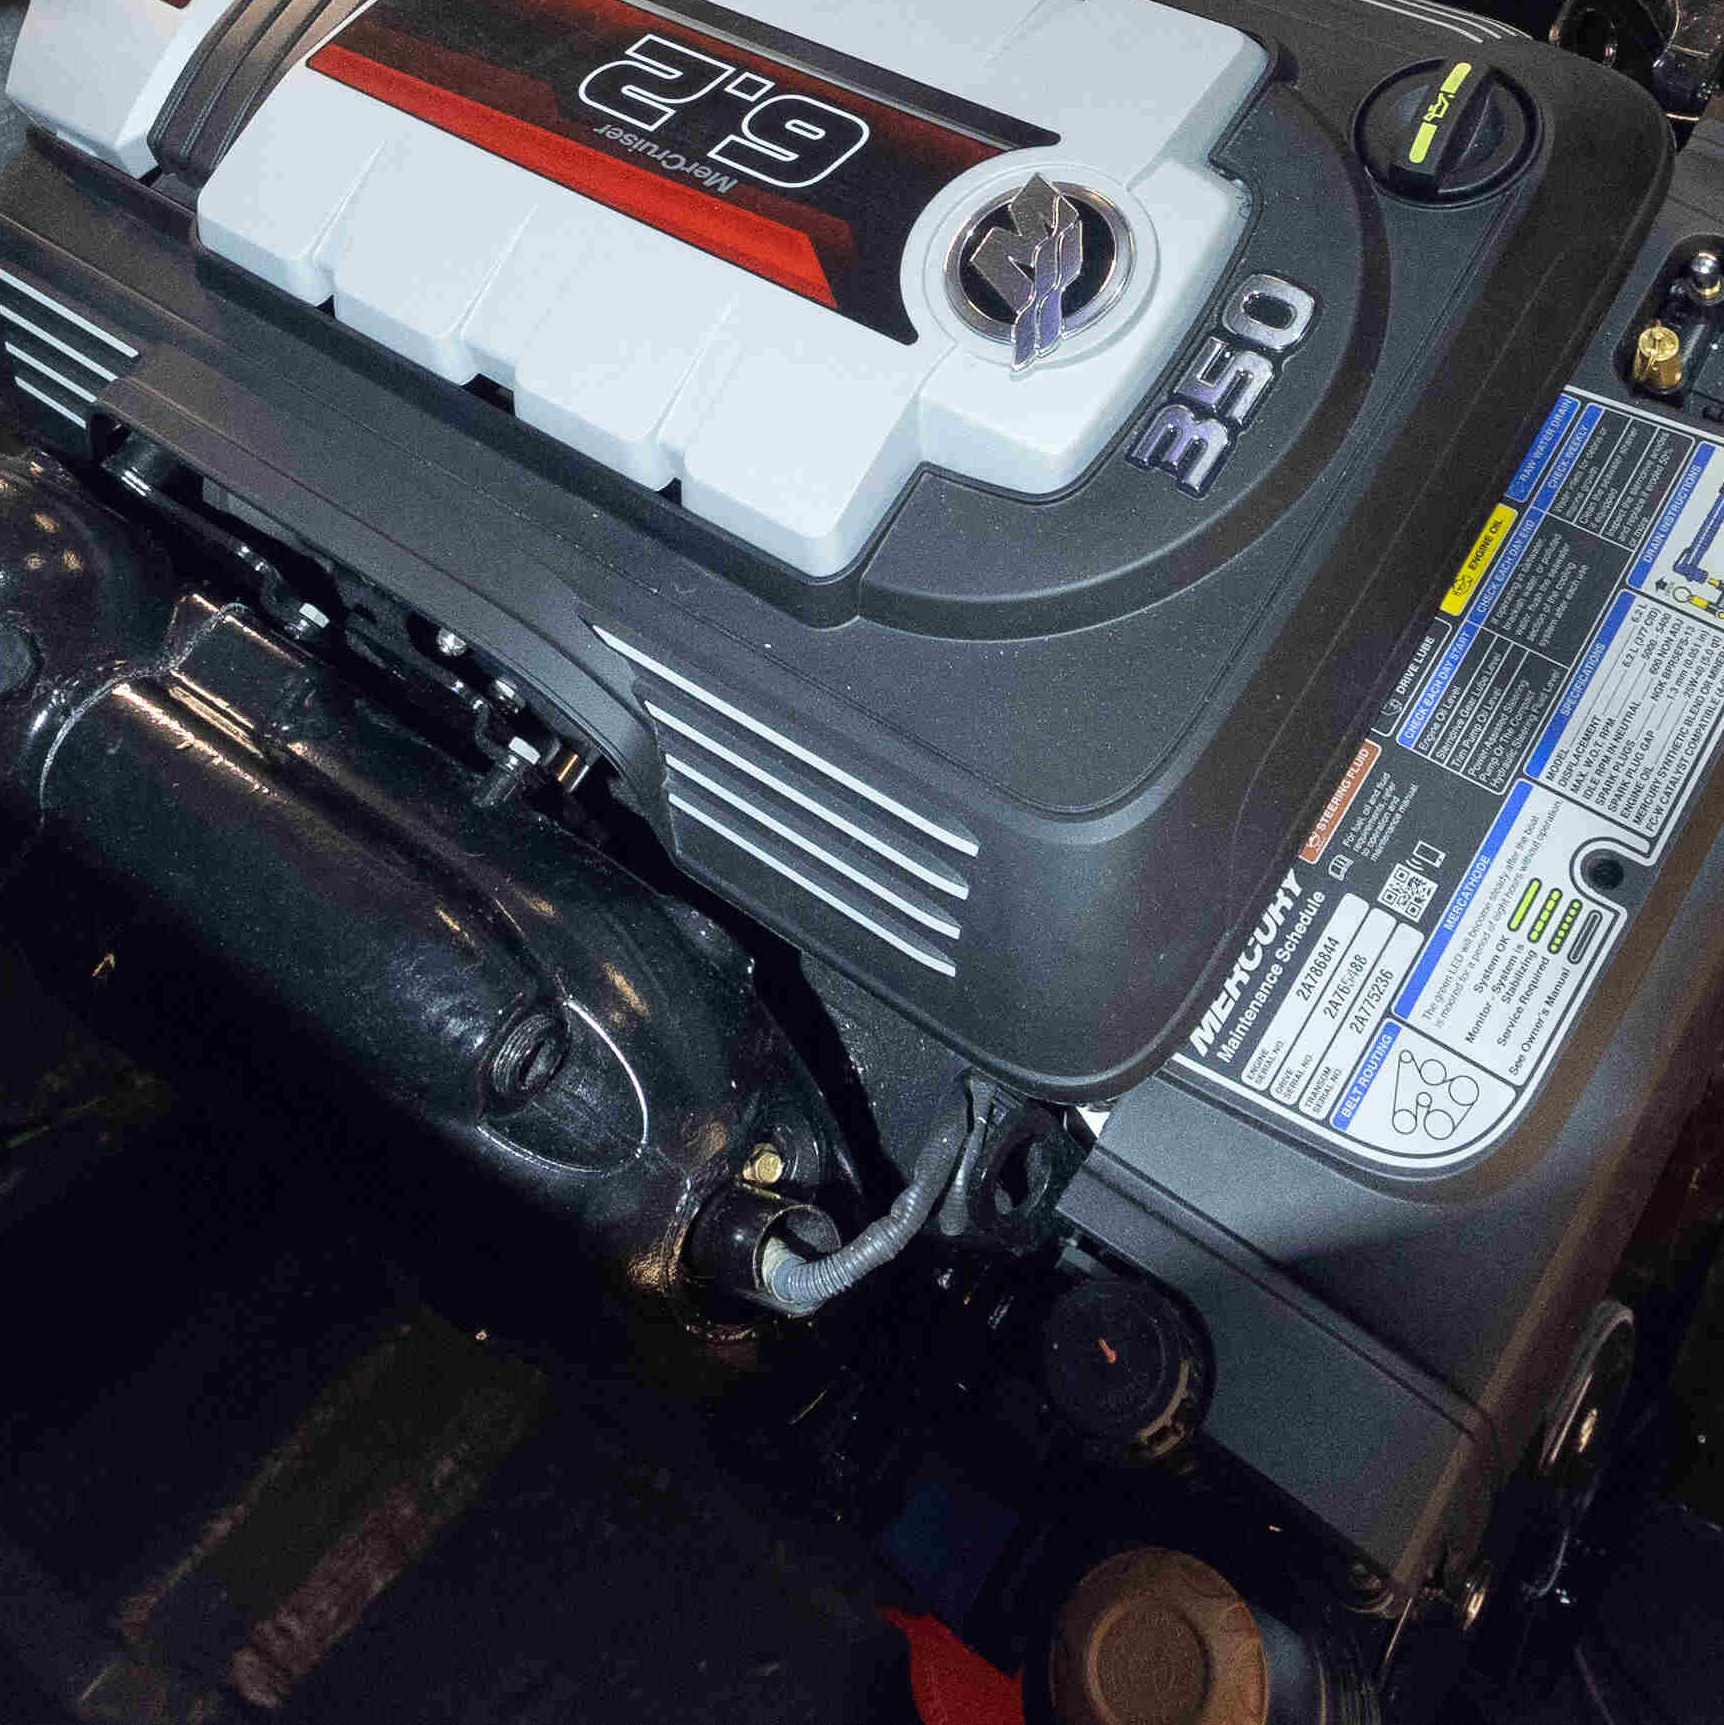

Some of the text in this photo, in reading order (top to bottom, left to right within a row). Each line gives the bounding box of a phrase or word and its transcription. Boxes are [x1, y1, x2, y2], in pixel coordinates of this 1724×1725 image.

[578, 33, 871, 189] 6.2
[594, 123, 739, 194] MerCruiser
[1126, 273, 1316, 493] 350
[1518, 398, 1572, 481] RAW WATER DRAIN
[1546, 424, 1587, 487] CHECK WEEKLY
[1466, 518, 1502, 570] ENGINE OIL
[1642, 464, 1701, 563] DRAIN INSTRUCTIONS
[1476, 518, 1535, 613] CHECK EACH DAY END
[1394, 635, 1435, 694] DRIVE LUBE
[1402, 629, 1471, 739] CHECK EACH DAY START
[1458, 695, 1476, 718] Gear
[1470, 674, 1489, 696] Lube
[1482, 651, 1502, 675] Level
[1503, 678, 1531, 714] Steering
[1545, 746, 1569, 781] MODEL
[1629, 608, 1643, 623] 6.2
[1556, 606, 1662, 787] DISPLACEMENT 6.2 L (377 CID)
[1560, 642, 1605, 716] SPECIFICATIONS
[1598, 716, 1615, 739] RPM
[1640, 638, 1658, 660] 5000
[1654, 611, 1671, 634] 5400
[1418, 683, 1462, 752] Engine Oil Level
[1450, 686, 1502, 767] Trim Pump Oil Level
[1478, 689, 1538, 783] Pump Or The Compact
[1510, 712, 1539, 749] Steering
[1530, 691, 1548, 713] Fluid
[1542, 669, 1561, 692] Level
[1581, 617, 1684, 799] IDLE RPM IN NEUTRAL 600 NON ADJ
[1594, 772, 1618, 806] SPARK
[1612, 739, 1636, 772] PLUGS
[1649, 679, 1666, 701] NGK
[1607, 779, 1630, 812] SPARK
[1625, 750, 1645, 778] PLUG
[1639, 729, 1657, 751] GAP
[1666, 686, 1679, 700] 1.3
[1675, 669, 1688, 686] mm
[1315, 747, 1369, 831] STEERING FLUID
[1618, 780, 1645, 818] ENGINE
[1638, 762, 1654, 781] OIL
[1631, 777, 1662, 825] MERCURY
[1656, 725, 1689, 778] SYNTHETIC
[1682, 694, 1705, 726] BLEND
[1699, 679, 1713, 695] OR
[1658, 756, 1689, 805] CATALYST
[1683, 696, 1721, 756] COMPATIBLE
[1421, 813, 1539, 1021] The green LED will become steady after the boat
[1442, 853, 1490, 931] MERCATHODE
[1183, 867, 1310, 1056] MERCURY
[1215, 888, 1326, 1062] Maintenance Schedule
[1294, 935, 1340, 1001] 2A786844
[1348, 968, 1394, 1034] 2A775236
[1463, 1000, 1493, 1043] Monitor
[1490, 953, 1521, 995] System
[1512, 942, 1525, 954] is
[1472, 934, 1510, 994] System OK
[1496, 955, 1552, 1046] Service Required
[1499, 948, 1538, 1005] Stabilizing
[1507, 966, 1569, 1075] See Owner's Manual
[1245, 1048, 1268, 1080] ENGINE
[1254, 1055, 1275, 1084] SERIAL
[1274, 1067, 1294, 1094] DRIVE
[1282, 1069, 1304, 1098] SERIAL
[1303, 1065, 1331, 1108] TRANSOM
[1312, 1083, 1333, 1112] SERIAL
[1341, 1033, 1392, 1118] BELT ROUTING
